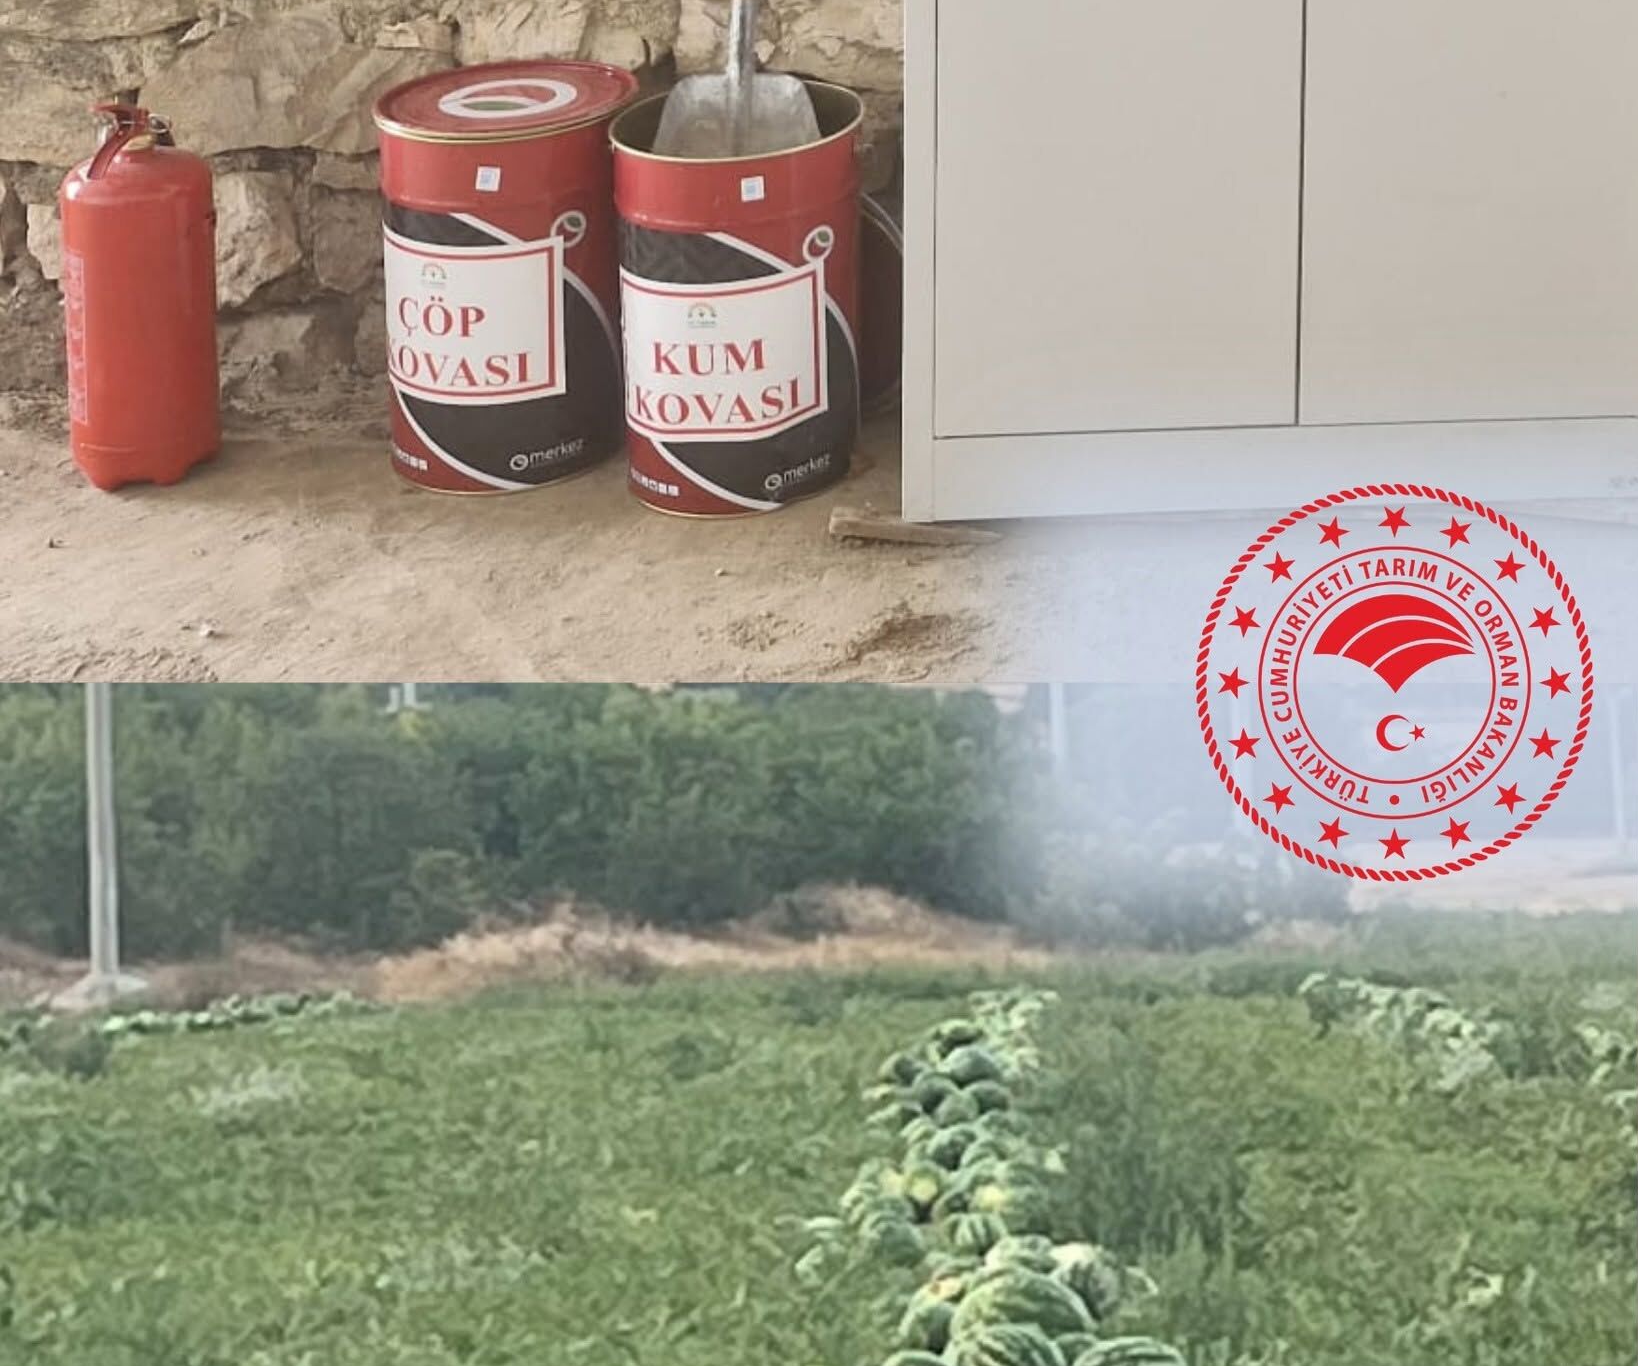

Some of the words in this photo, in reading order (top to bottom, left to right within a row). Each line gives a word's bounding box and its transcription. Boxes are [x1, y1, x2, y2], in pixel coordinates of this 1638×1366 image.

[398, 294, 486, 339] ÇÖP
[653, 338, 766, 376] KUM
[634, 375, 800, 425] KOVASI
[529, 438, 585, 464] merkez
[783, 453, 831, 483] merkez
